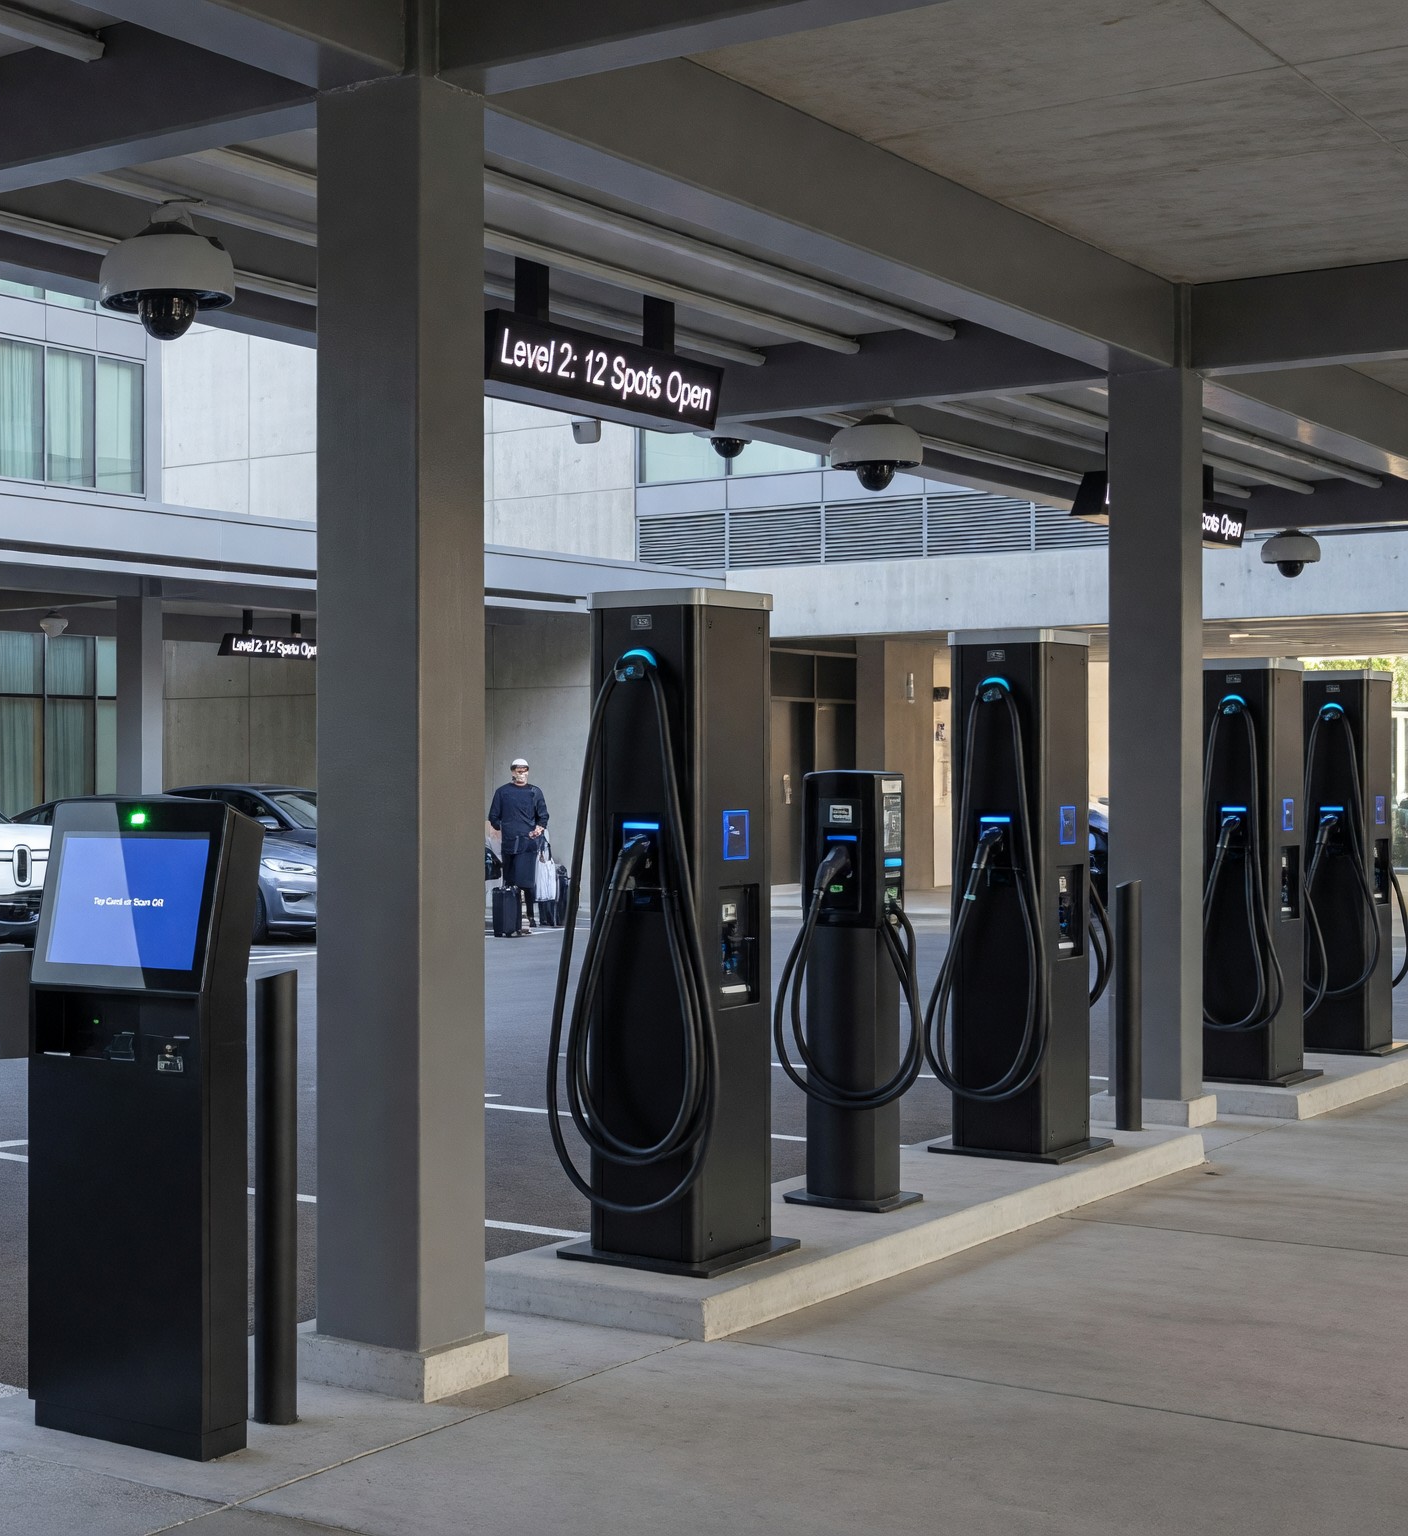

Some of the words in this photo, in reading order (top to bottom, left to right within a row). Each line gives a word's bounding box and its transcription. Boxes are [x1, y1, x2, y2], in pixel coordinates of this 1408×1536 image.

[501, 328, 556, 374] Level
[557, 342, 577, 379] 2:
[585, 350, 608, 386] 12
[610, 356, 662, 400] Spots
[666, 370, 712, 412] Open
[1221, 513, 1243, 541] Open
